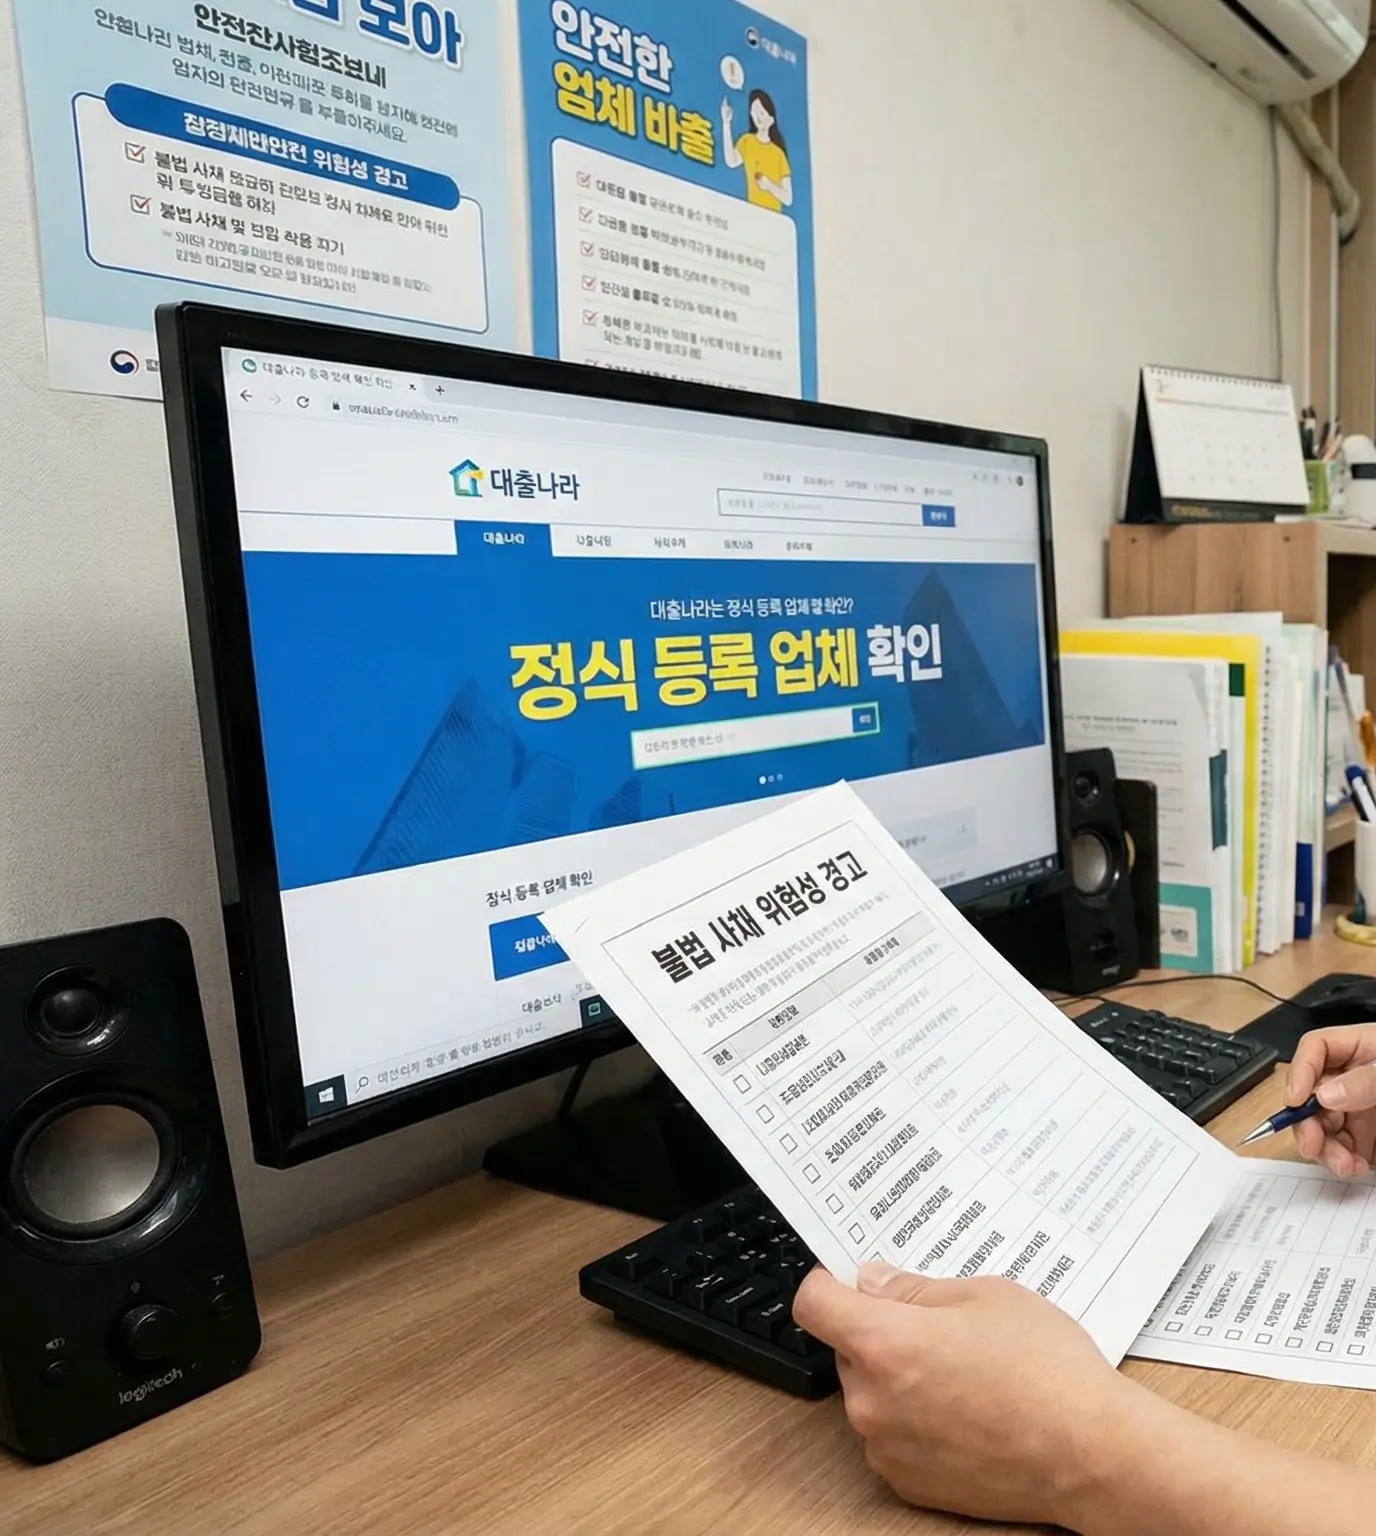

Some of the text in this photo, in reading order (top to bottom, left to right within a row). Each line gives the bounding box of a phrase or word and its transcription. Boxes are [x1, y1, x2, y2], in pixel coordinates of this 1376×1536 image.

[551, 0, 674, 94] 안전한
[489, 467, 581, 501] 대출나라
[650, 598, 725, 621] 대출나라는
[726, 598, 755, 618] 정식
[508, 622, 943, 722] 정식 등록 업체 확인
[650, 930, 717, 985] 불법
[707, 903, 766, 953] 사채
[755, 871, 827, 927] 위험성
[816, 849, 869, 892] 경고
